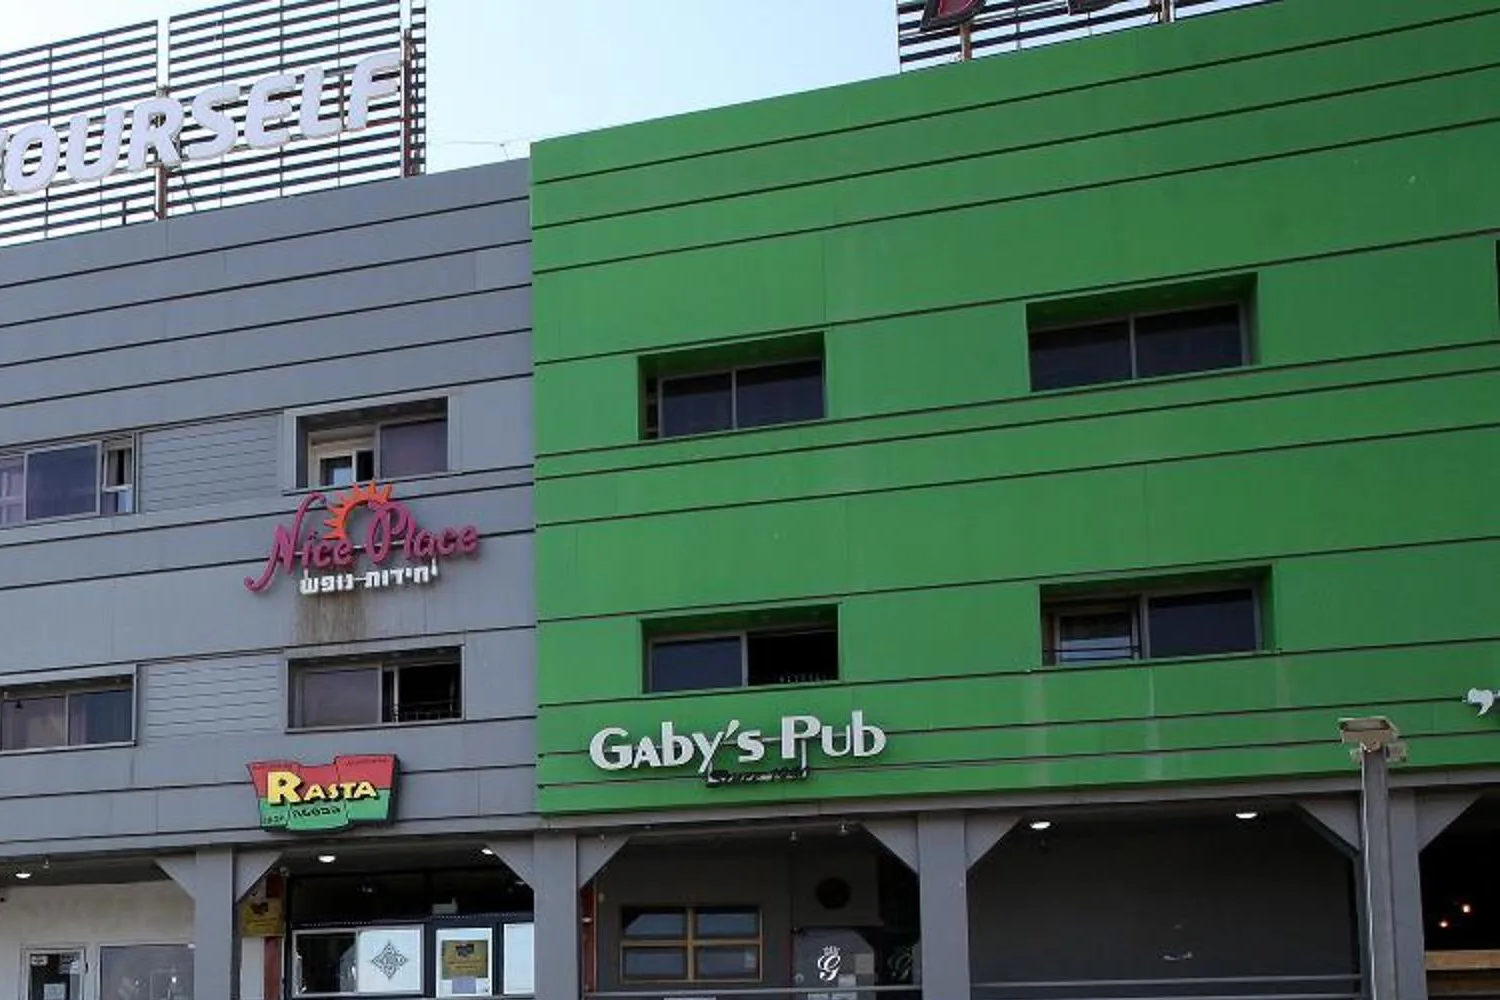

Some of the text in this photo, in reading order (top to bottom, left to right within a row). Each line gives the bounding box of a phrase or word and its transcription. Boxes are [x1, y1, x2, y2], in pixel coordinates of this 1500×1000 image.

[244, 491, 481, 592] Nice Place
[589, 709, 888, 774] Gaby's Pub
